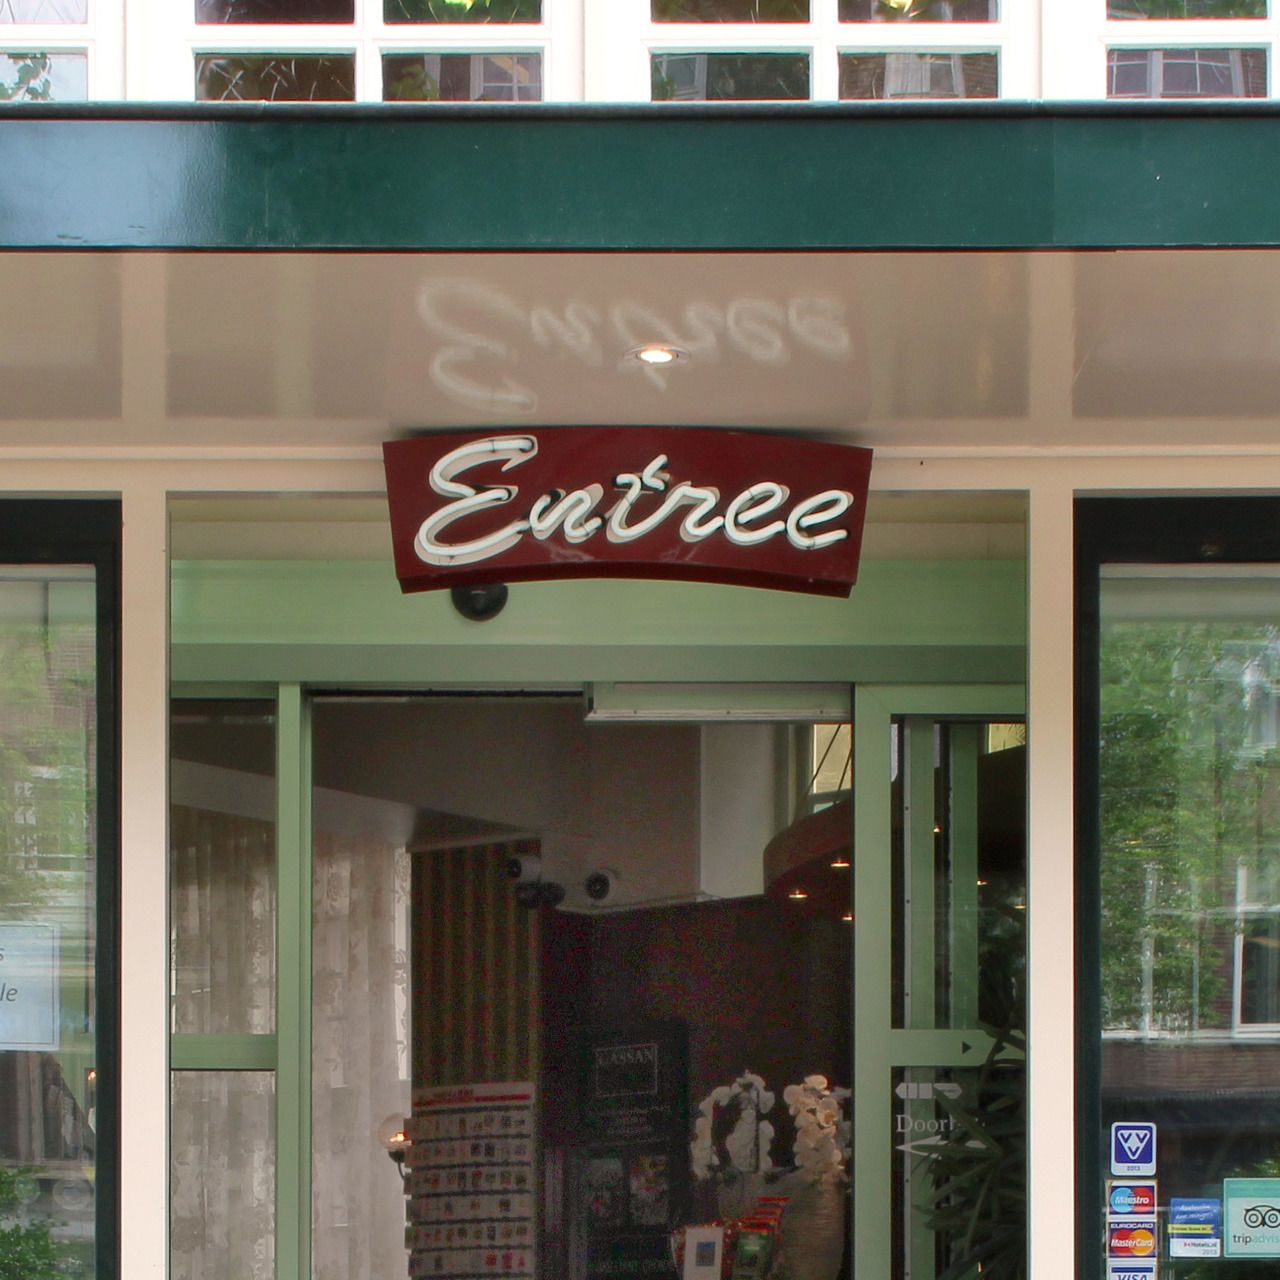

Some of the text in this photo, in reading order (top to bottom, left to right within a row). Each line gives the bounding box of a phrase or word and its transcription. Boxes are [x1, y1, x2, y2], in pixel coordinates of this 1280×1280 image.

[414, 435, 854, 566] Entree
[1114, 1195, 1150, 1205] Maestro
[1111, 1238, 1153, 1248] MasterCard
